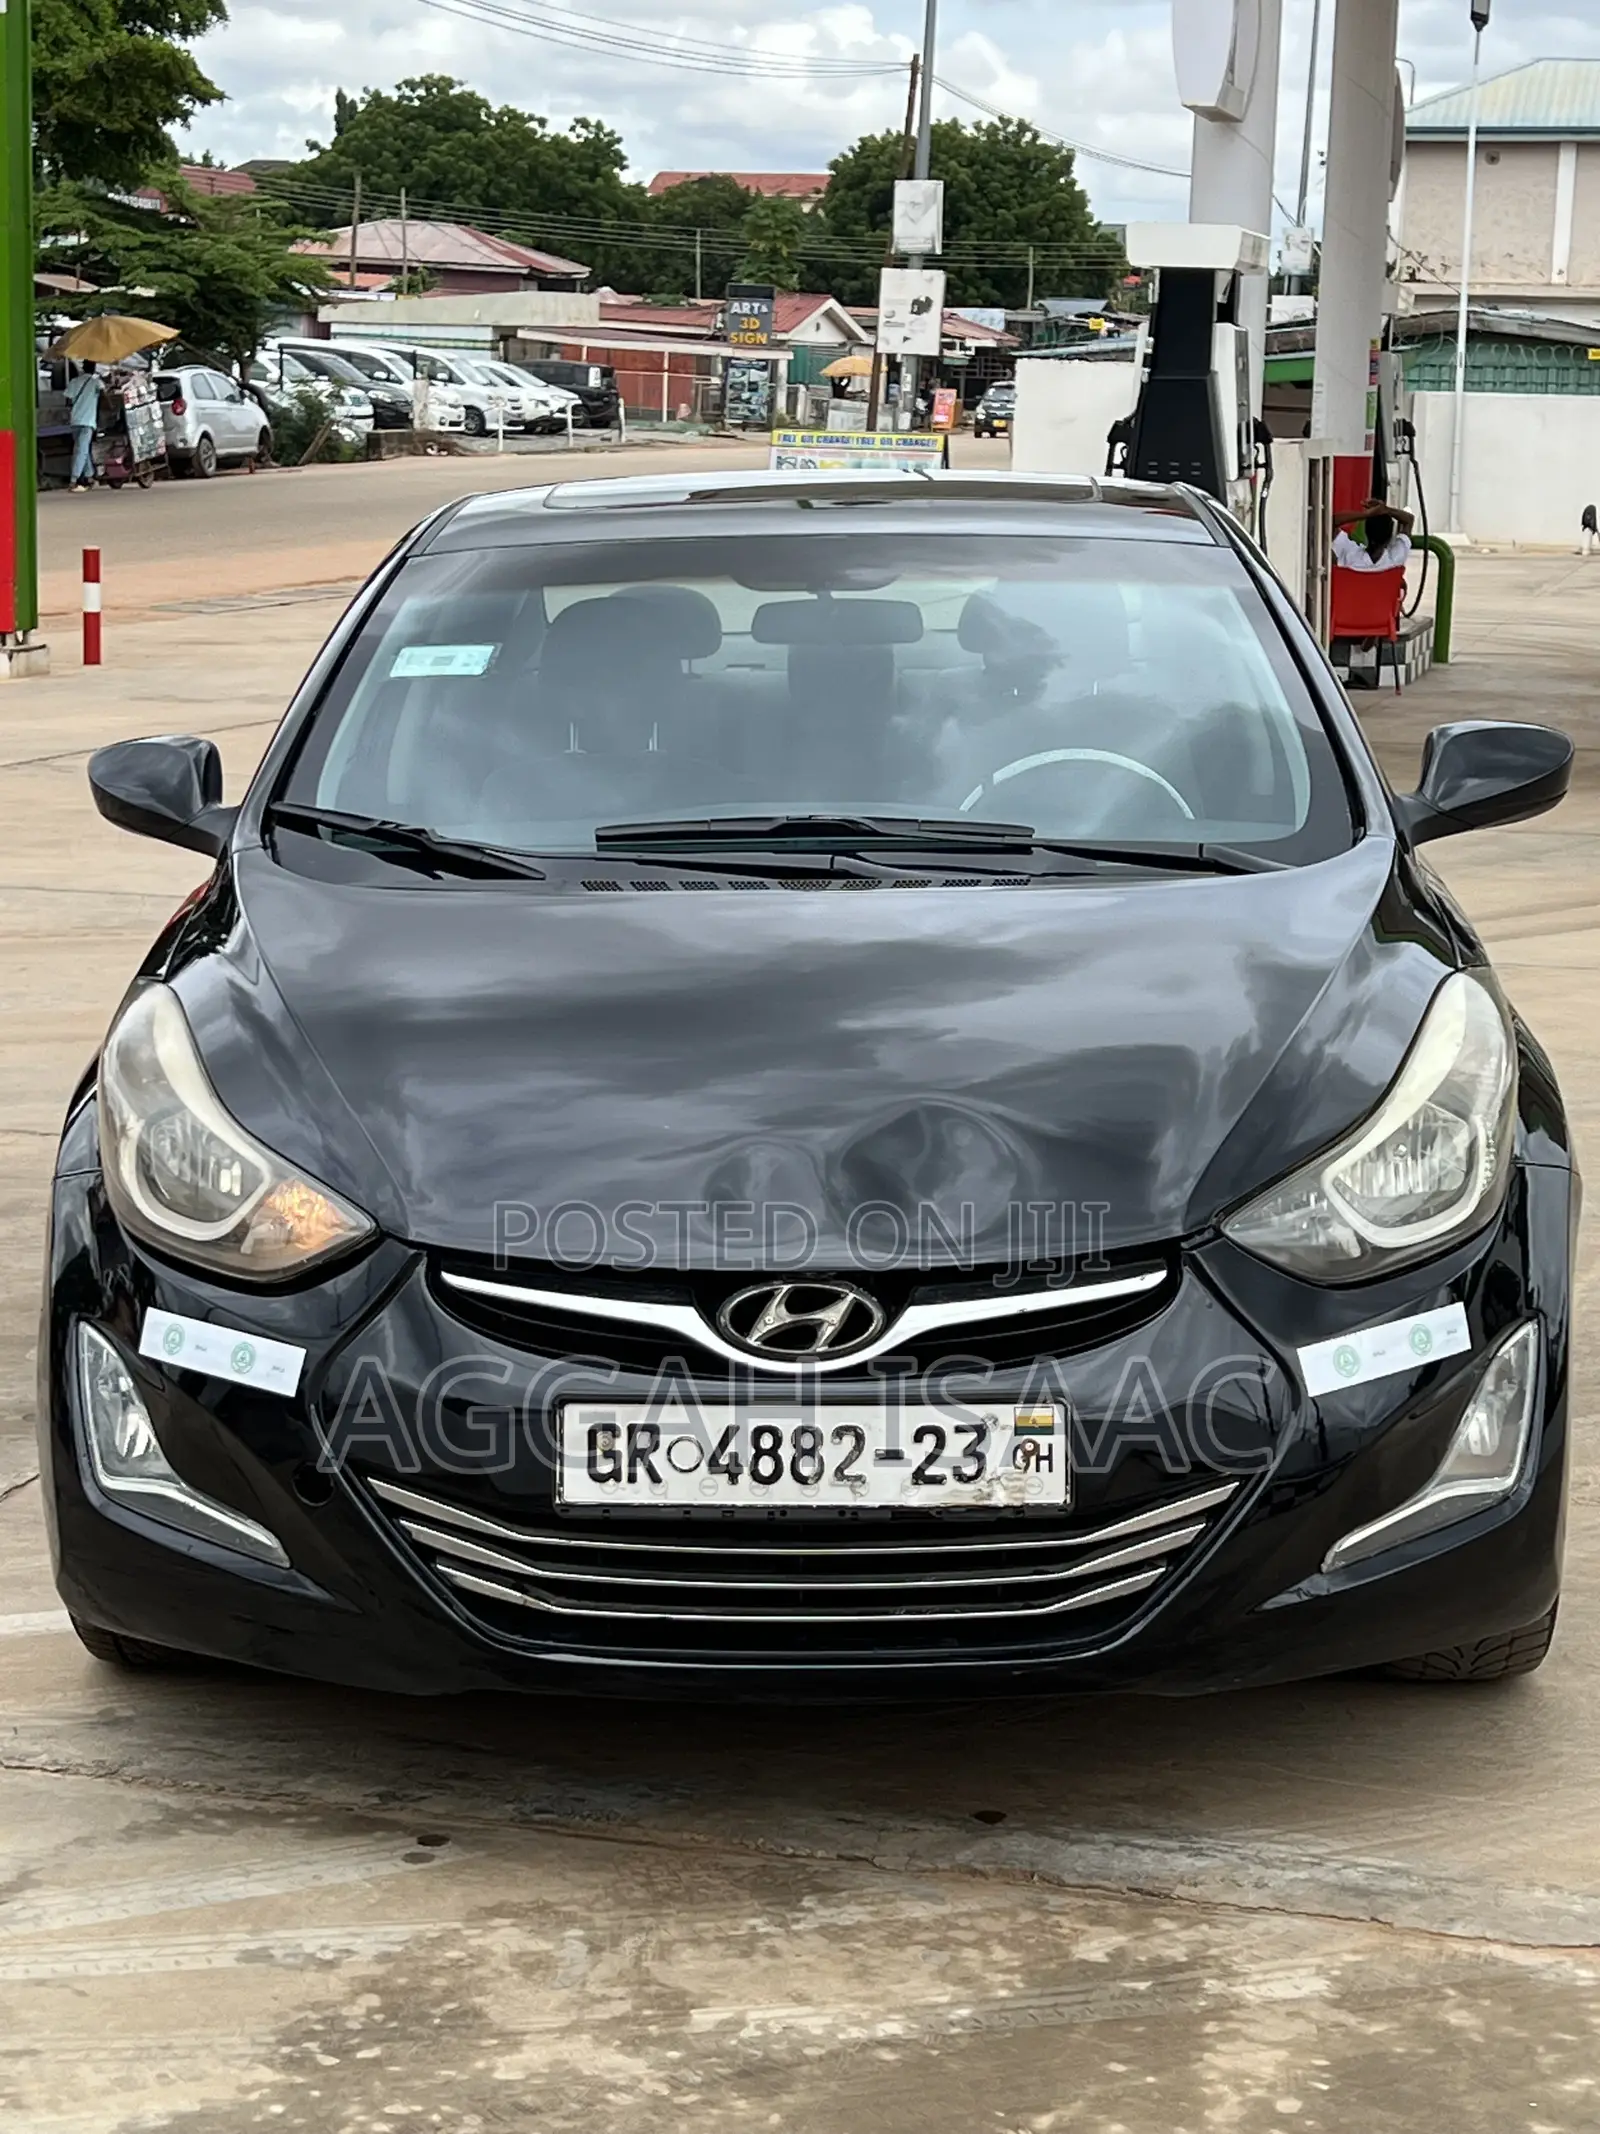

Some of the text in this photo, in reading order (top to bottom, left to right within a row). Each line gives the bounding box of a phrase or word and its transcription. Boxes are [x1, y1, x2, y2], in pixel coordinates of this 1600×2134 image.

[739, 317, 760, 330] 3D
[730, 332, 768, 345] SIGN
[587, 1423, 663, 1484] GR
